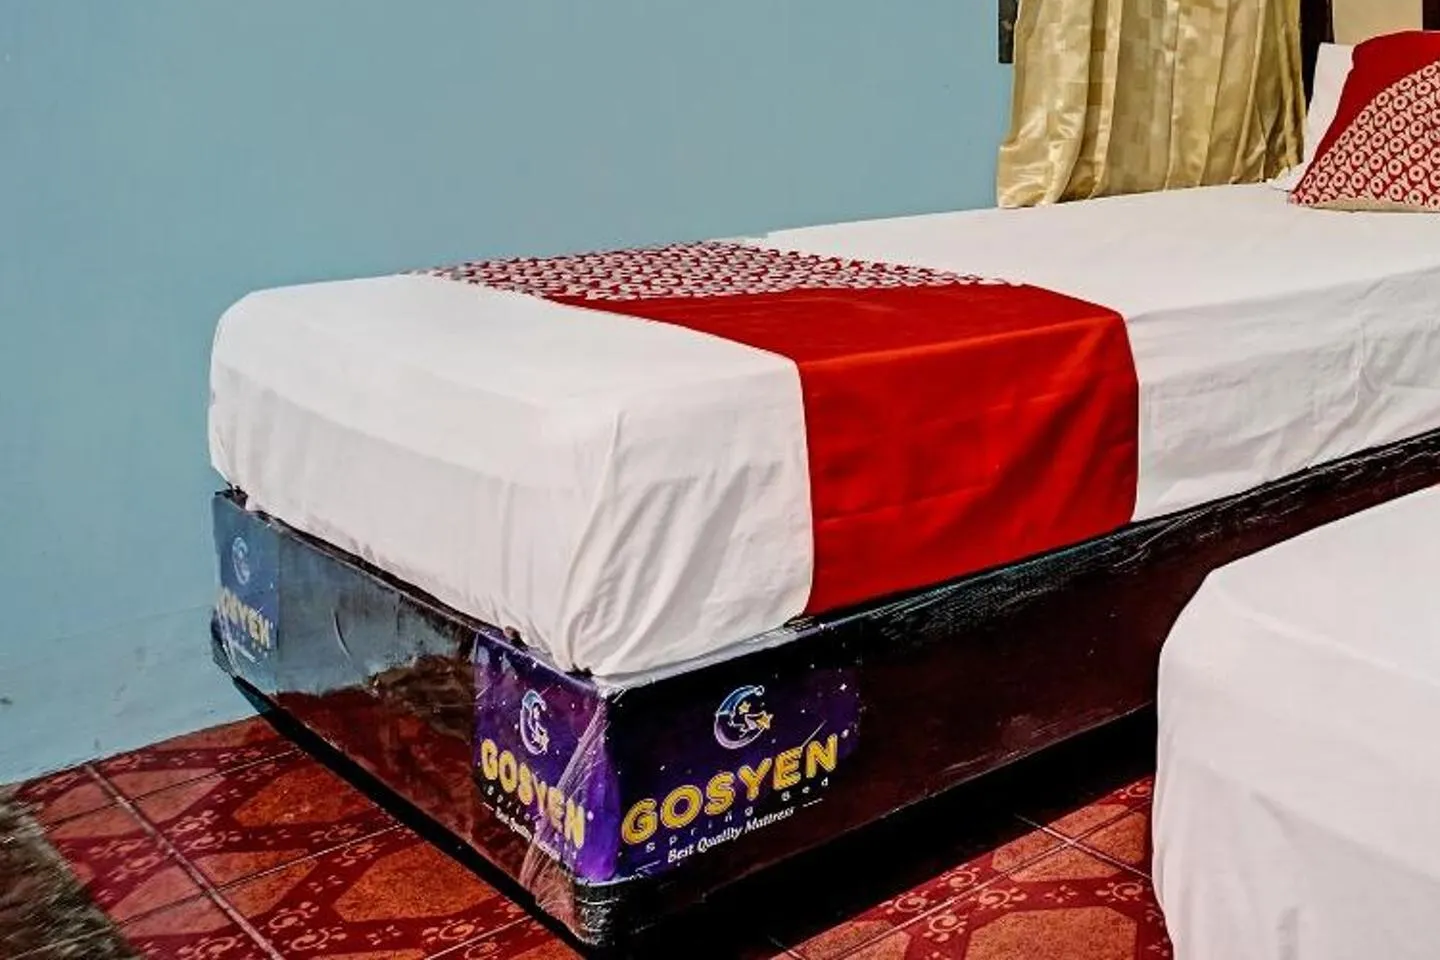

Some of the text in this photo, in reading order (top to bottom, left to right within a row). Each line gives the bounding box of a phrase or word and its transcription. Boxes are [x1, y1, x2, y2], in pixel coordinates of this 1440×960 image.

[480, 738, 585, 849] GOSYEN
[621, 733, 838, 845] GOSYEN
[667, 806, 796, 864] Best Quality Mattress
